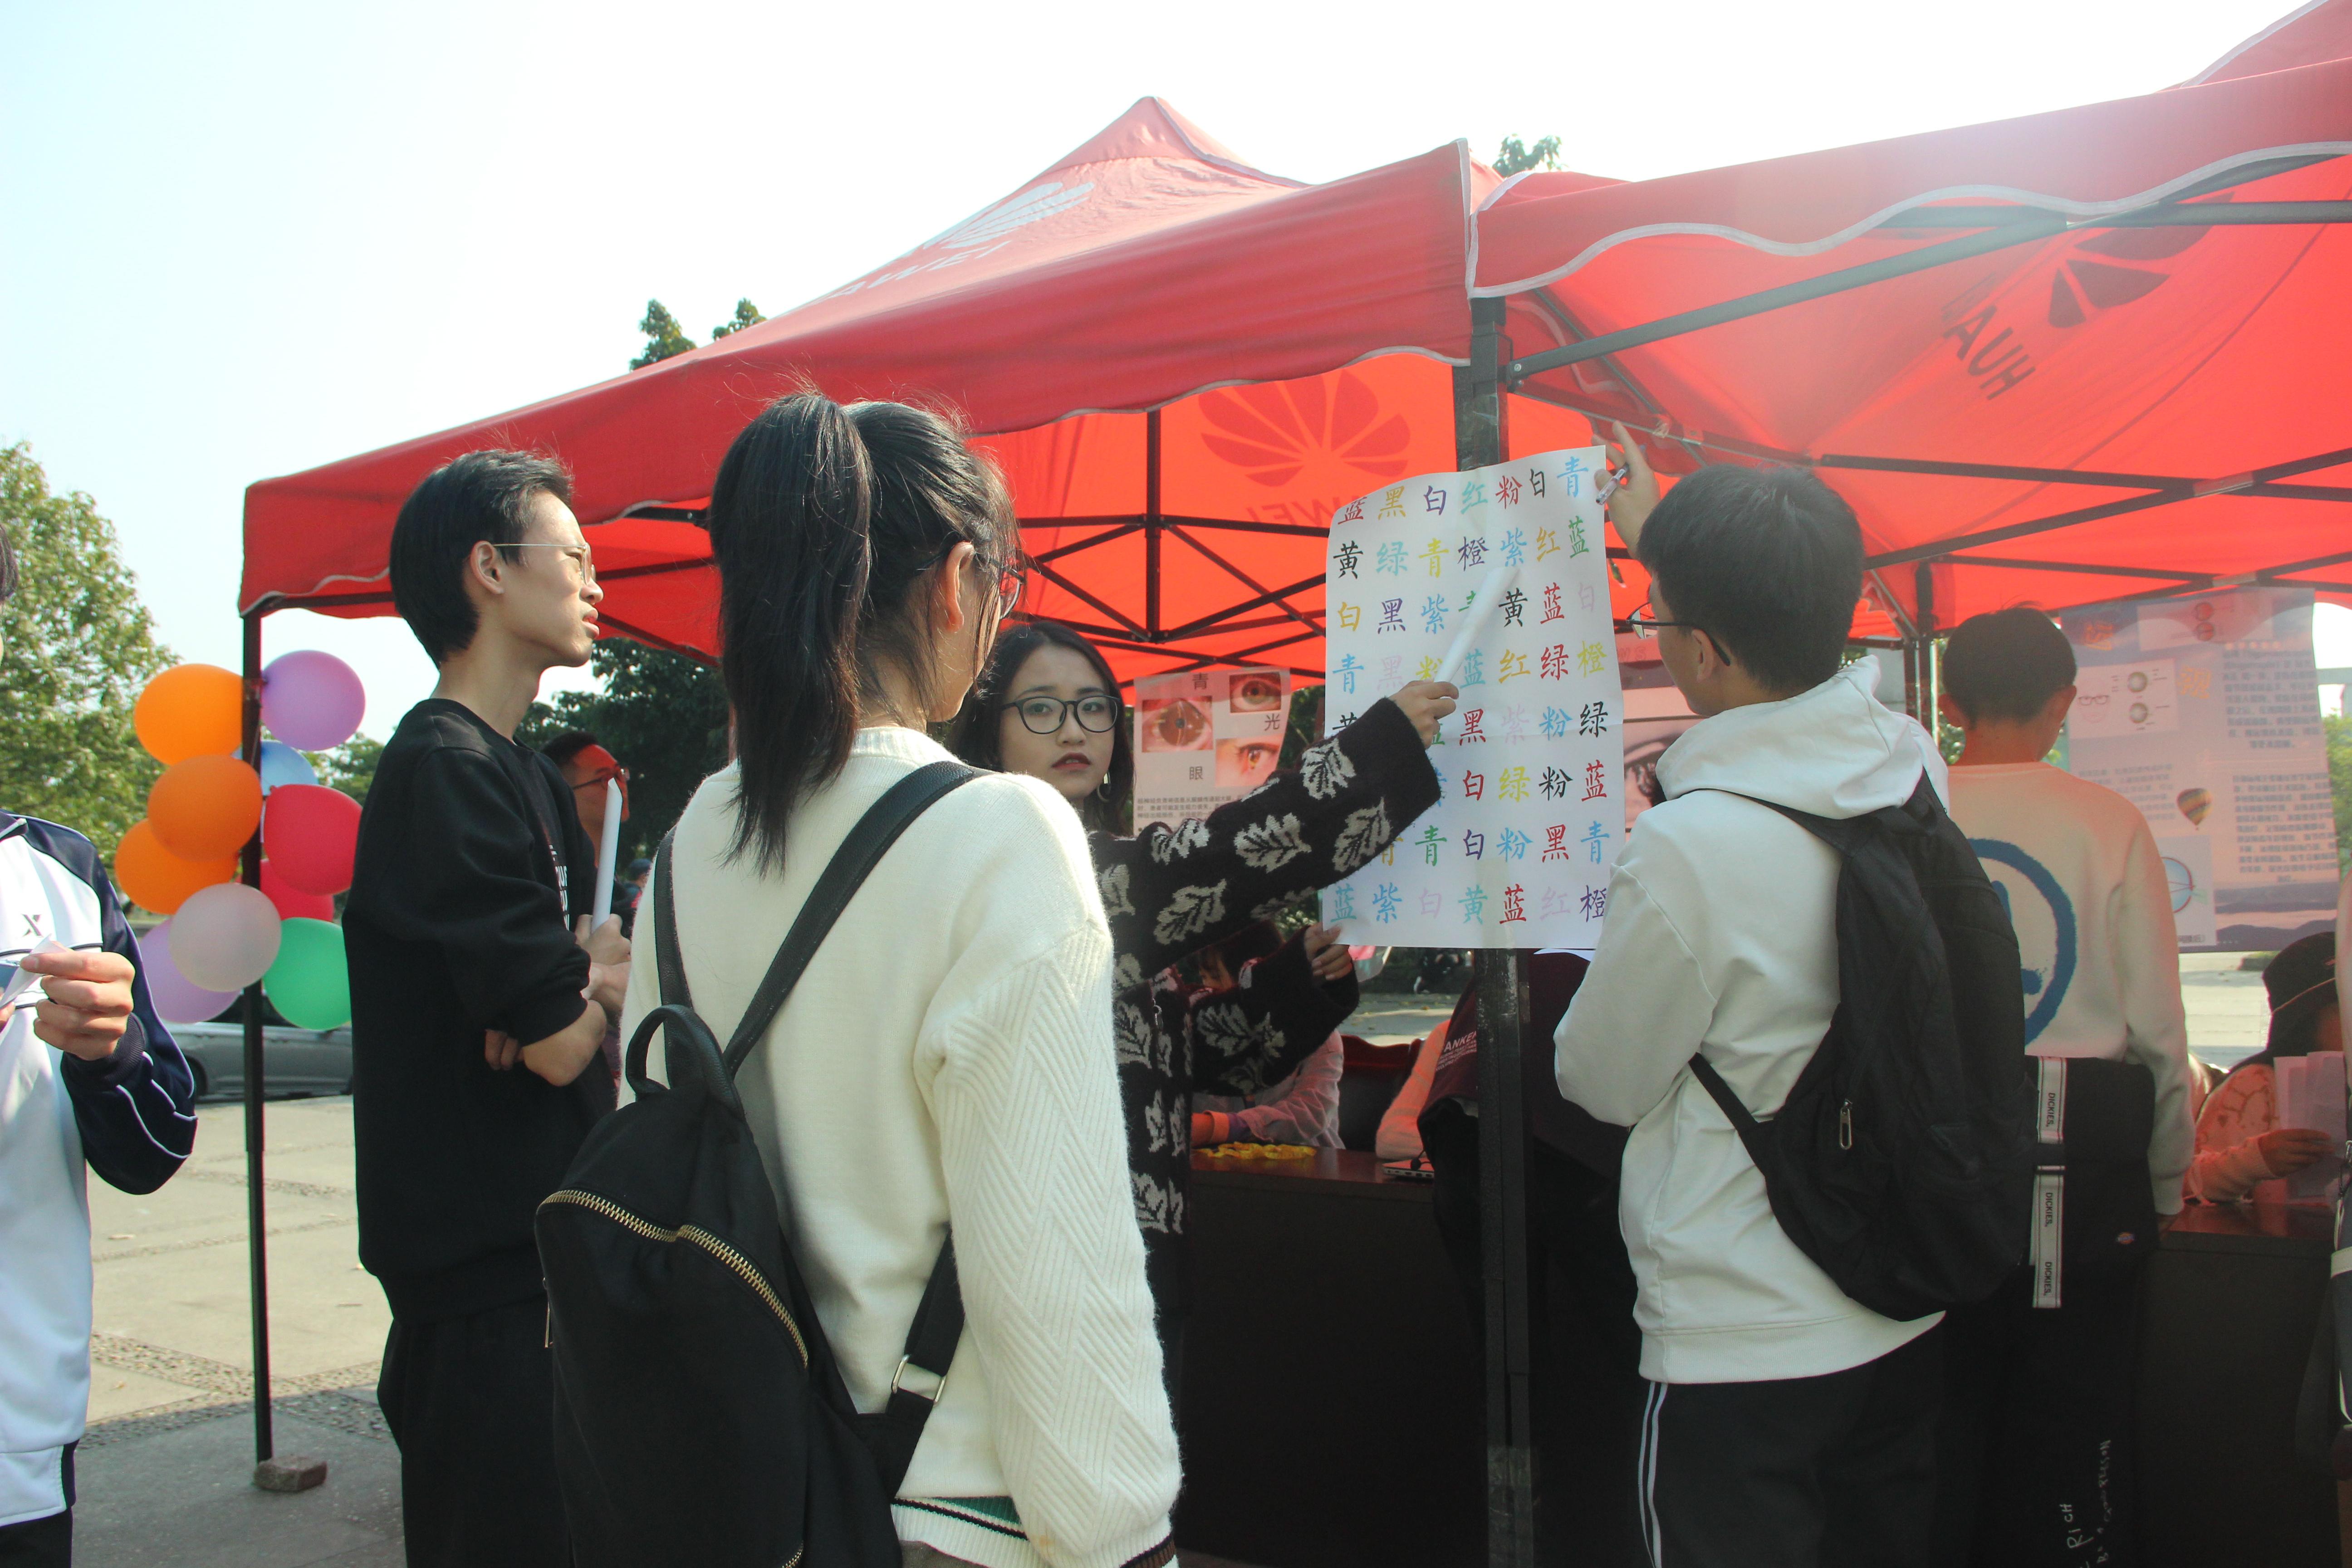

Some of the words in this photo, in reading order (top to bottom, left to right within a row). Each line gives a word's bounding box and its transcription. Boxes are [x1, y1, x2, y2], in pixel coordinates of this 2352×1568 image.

[1338, 496, 1367, 525] 蓝
[1377, 485, 1406, 520] 黑
[1423, 485, 1447, 515] 白
[1460, 480, 1488, 515] 红
[1495, 475, 1523, 509] 粉
[1529, 469, 1546, 499] 白
[1556, 456, 1588, 498] 青
[1333, 540, 1363, 579] 黄
[1376, 541, 1408, 576] 绿
[1418, 537, 1450, 578] 青
[1457, 536, 1489, 571] 橙
[1500, 527, 1527, 567] 紫
[1535, 526, 1561, 563] 红
[1568, 515, 1590, 559] 蓝
[1337, 601, 1361, 632] 白
[1377, 598, 1406, 634] 黑
[1421, 593, 1449, 634] 紫
[1498, 587, 1528, 628] 黄
[1540, 582, 1565, 624] 蓝
[1578, 583, 1595, 612] 白
[1193, 673, 1209, 690] 青
[1333, 653, 1364, 694] 青
[1377, 655, 1404, 691] 黑
[1459, 648, 1486, 689] 蓝
[1498, 648, 1531, 684] 红
[1540, 644, 1569, 681] 绿
[1576, 640, 1607, 678] 橙
[1264, 714, 1280, 731] 光
[1459, 708, 1486, 745] 黑
[1501, 703, 1529, 745] 紫
[1539, 706, 1573, 739] 粉
[1579, 701, 1608, 738] 绿
[1189, 766, 1203, 780] 眼
[1462, 770, 1485, 801] 白
[1499, 766, 1531, 802] 绿
[1539, 766, 1573, 801] 粉
[1581, 759, 1607, 802] 蓝
[1415, 825, 1448, 866] 青
[1463, 829, 1485, 861] 白
[1497, 827, 1534, 862] 粉
[1542, 824, 1569, 862] 黑
[1581, 821, 1610, 864] 青
[1330, 882, 1357, 923] 蓝
[1372, 882, 1402, 923] 紫
[1419, 887, 1442, 919] 白
[1458, 884, 1488, 925] 黄
[1499, 883, 1526, 924] 蓝
[1539, 886, 1571, 921] 红
[1579, 885, 1607, 922] 橙
[1443, 1031, 1477, 1052] ANKE
